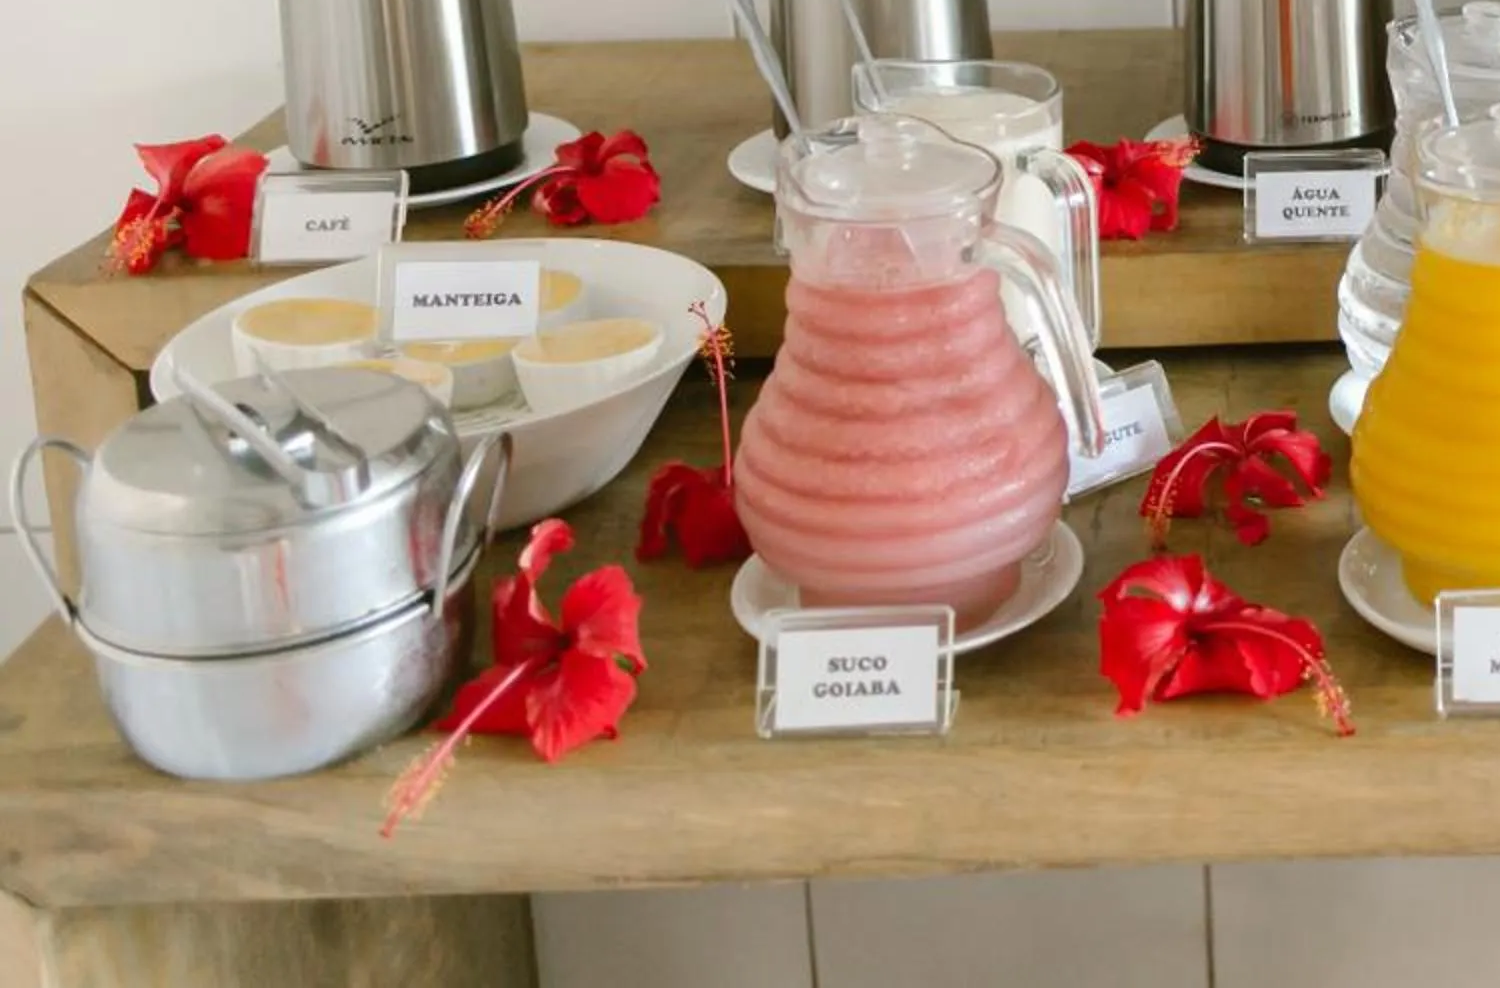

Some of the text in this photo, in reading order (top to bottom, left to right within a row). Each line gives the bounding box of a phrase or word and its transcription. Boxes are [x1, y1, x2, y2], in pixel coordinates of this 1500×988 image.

[1291, 186, 1341, 201] ÁGUA
[1282, 205, 1351, 220] QUENTE
[304, 214, 351, 232] CAFÉ
[412, 292, 523, 308] MANTEIGA
[1103, 420, 1144, 445] GUTE
[827, 656, 889, 673] SUCO
[813, 680, 902, 699] GOIABA
